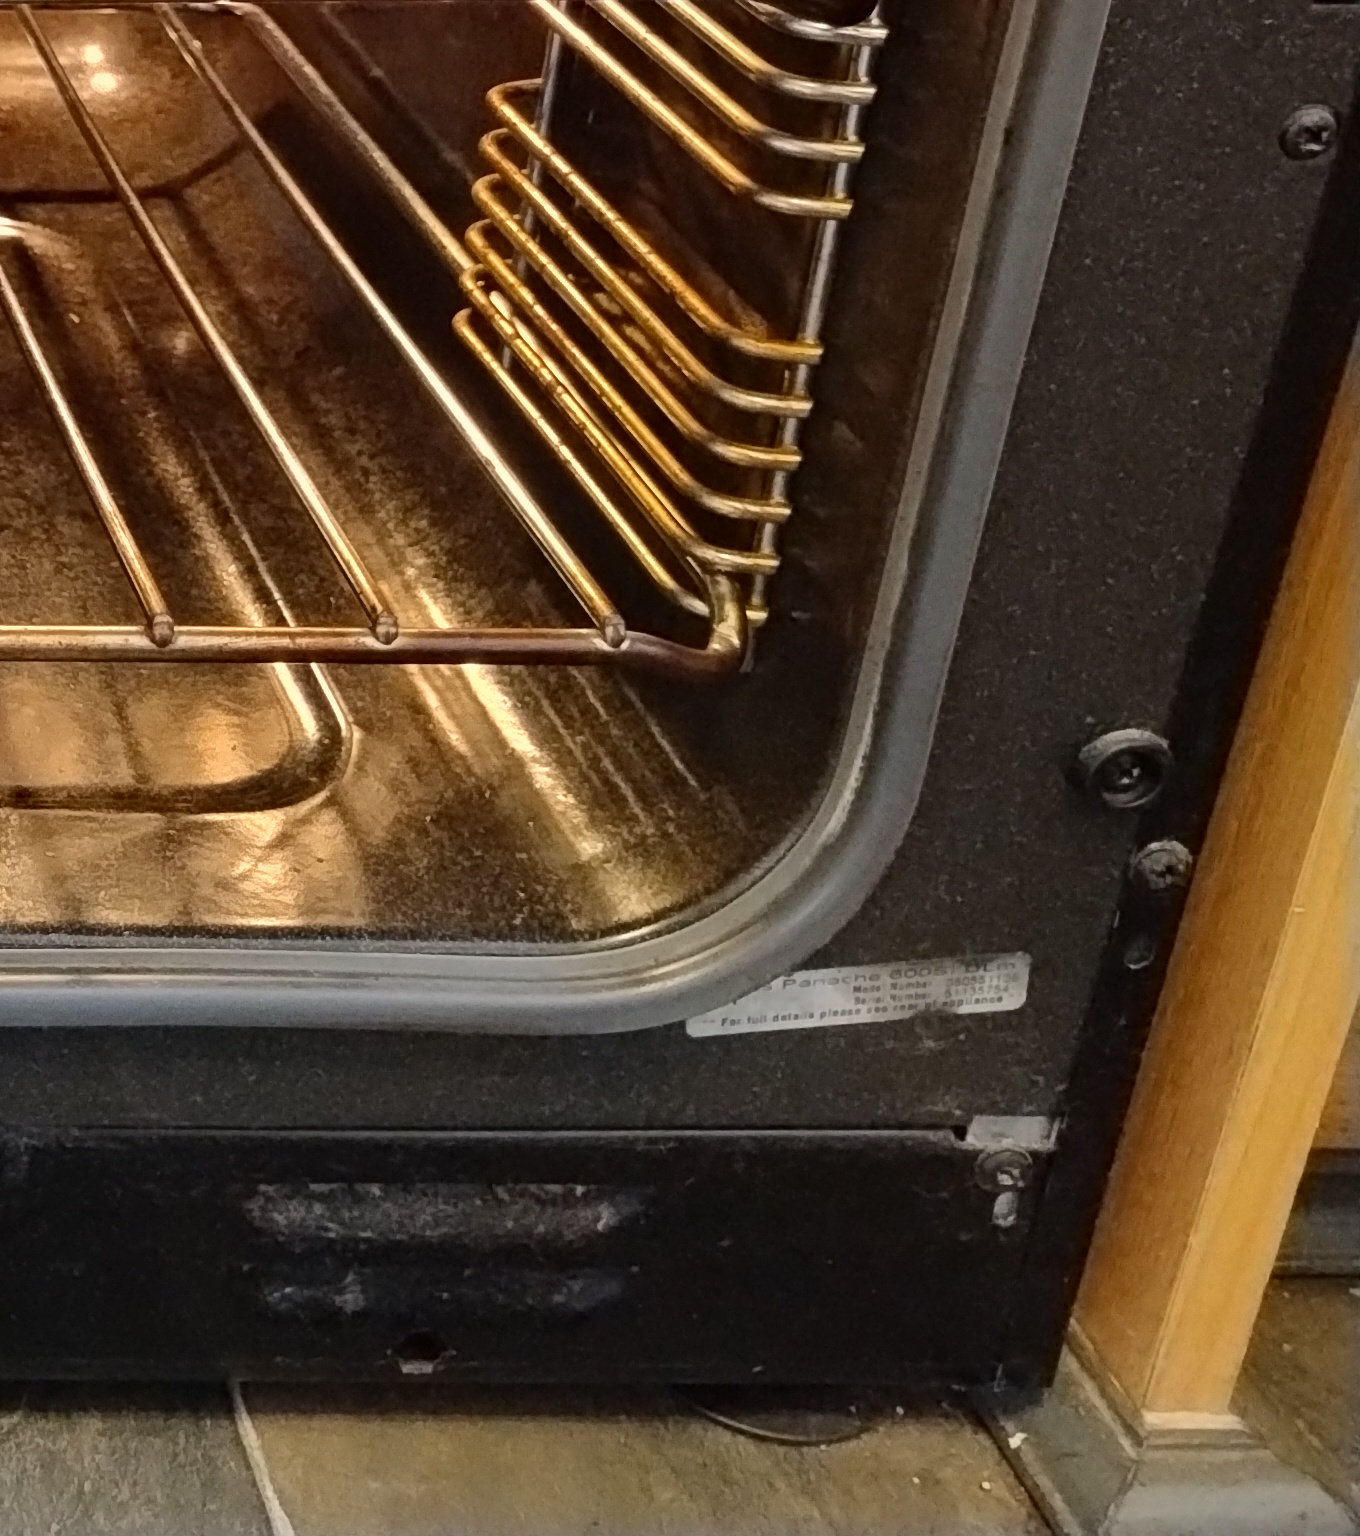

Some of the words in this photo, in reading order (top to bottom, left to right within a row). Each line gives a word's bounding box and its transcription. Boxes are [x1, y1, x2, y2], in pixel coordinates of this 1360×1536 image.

[783, 972, 880, 989] Panache
[721, 1017, 742, 1026] For
[747, 1014, 767, 1024] full
[772, 1011, 814, 1023] details
[820, 1007, 861, 1020] please
